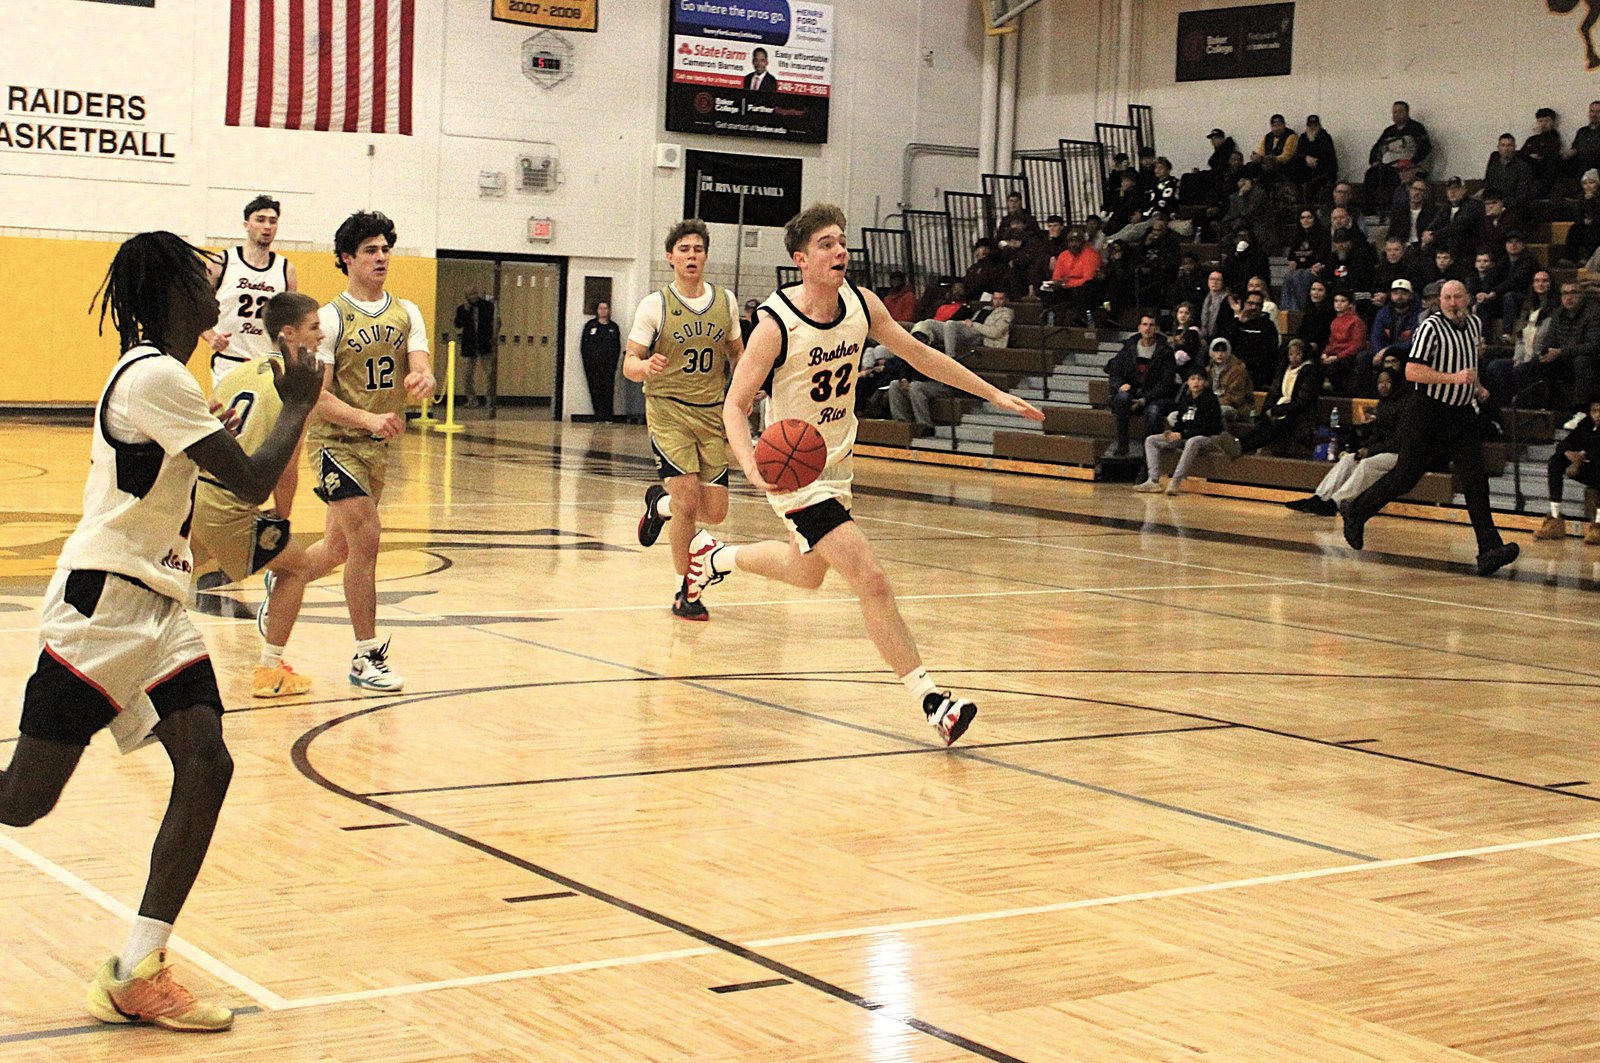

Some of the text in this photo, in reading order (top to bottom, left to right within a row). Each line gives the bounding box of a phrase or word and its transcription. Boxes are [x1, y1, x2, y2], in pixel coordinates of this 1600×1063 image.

[509, 1, 540, 15] 2007
[550, 6, 581, 19] 2008
[680, 0, 786, 24] Go where the pros go.
[797, 17, 817, 26] FORD
[682, 57, 745, 72] Cameron Barnes
[775, 51, 828, 64] Easy affordable
[778, 60, 825, 73] life insurance
[8, 85, 146, 121] RAIDERS
[236, 277, 275, 293] Brother
[237, 293, 268, 319] 22
[239, 322, 263, 336] Rice
[347, 324, 406, 353] SOUTH
[673, 321, 725, 344] SOUTH
[682, 347, 714, 374] 30
[808, 340, 860, 367] Brother
[365, 355, 395, 391] 12
[810, 362, 853, 402] 32
[817, 406, 847, 425] Rice
